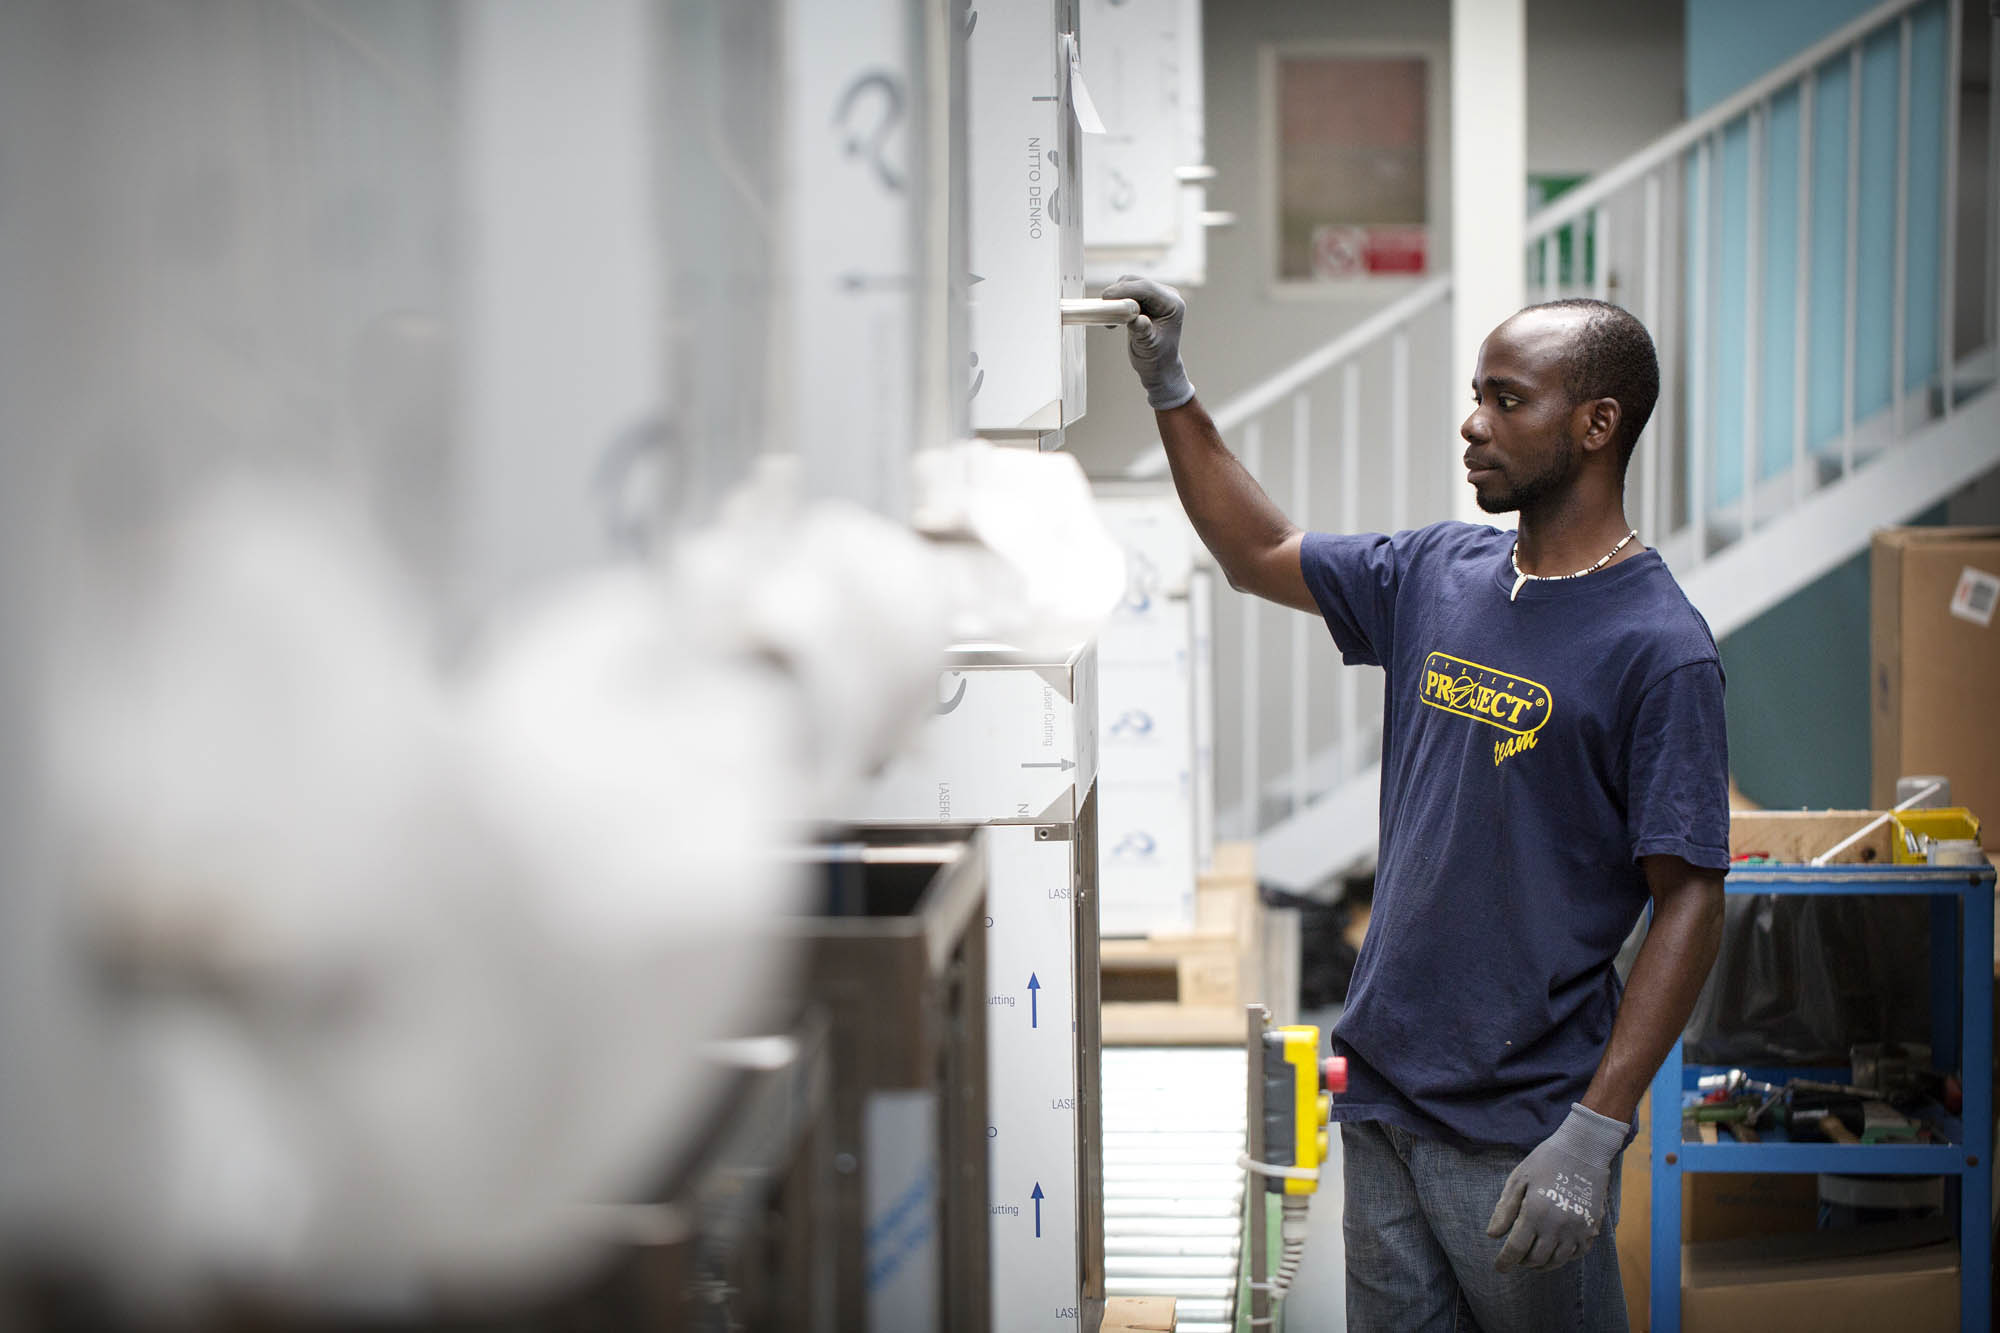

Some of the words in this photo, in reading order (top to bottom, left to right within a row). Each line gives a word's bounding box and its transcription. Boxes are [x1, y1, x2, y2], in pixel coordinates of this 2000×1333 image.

[1027, 136, 1041, 182] NITTO
[1029, 186, 1042, 240] DENKO
[1431, 658, 1535, 696] SYSTEMS
[1043, 686, 1053, 710] Laser
[1425, 669, 1534, 724] PROJECT
[1042, 713, 1056, 747] Cutting
[1494, 730, 1539, 767] team
